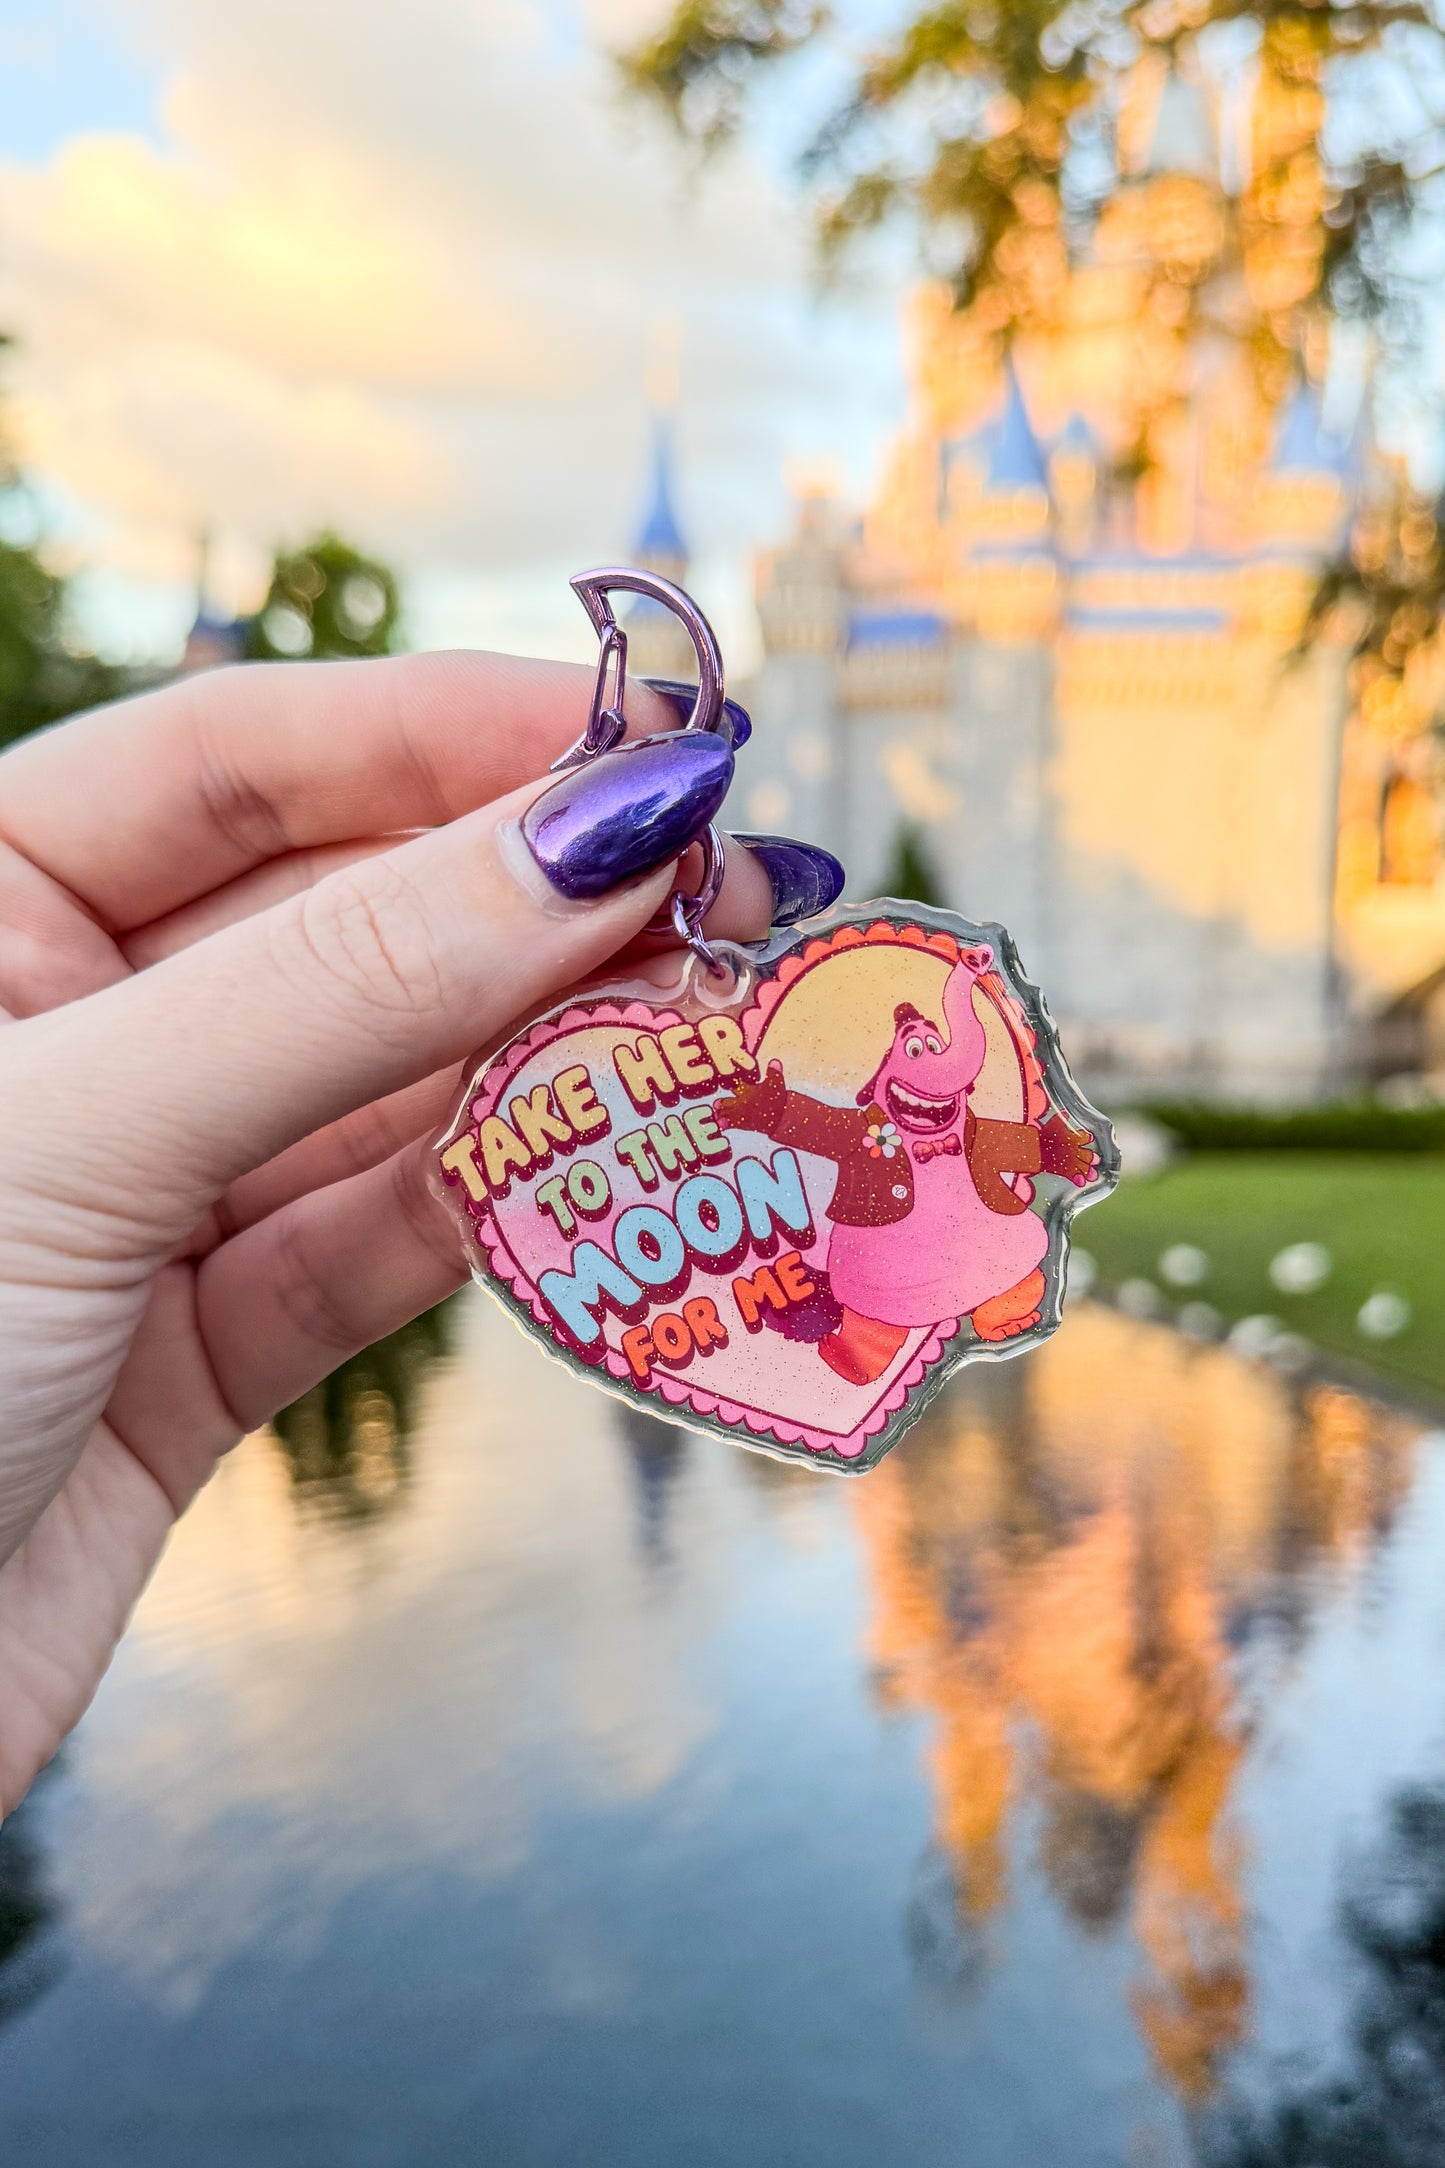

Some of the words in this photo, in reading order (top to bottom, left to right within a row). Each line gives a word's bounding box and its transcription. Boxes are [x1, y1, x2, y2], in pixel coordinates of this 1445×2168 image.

[440, 1064, 609, 1203] TAKE
[612, 1014, 758, 1112] HER
[536, 1160, 612, 1238] TO
[614, 1104, 730, 1190] THE
[536, 1146, 814, 1350] MOON
[620, 1296, 728, 1384] FOR
[732, 1251, 816, 1332] ME
